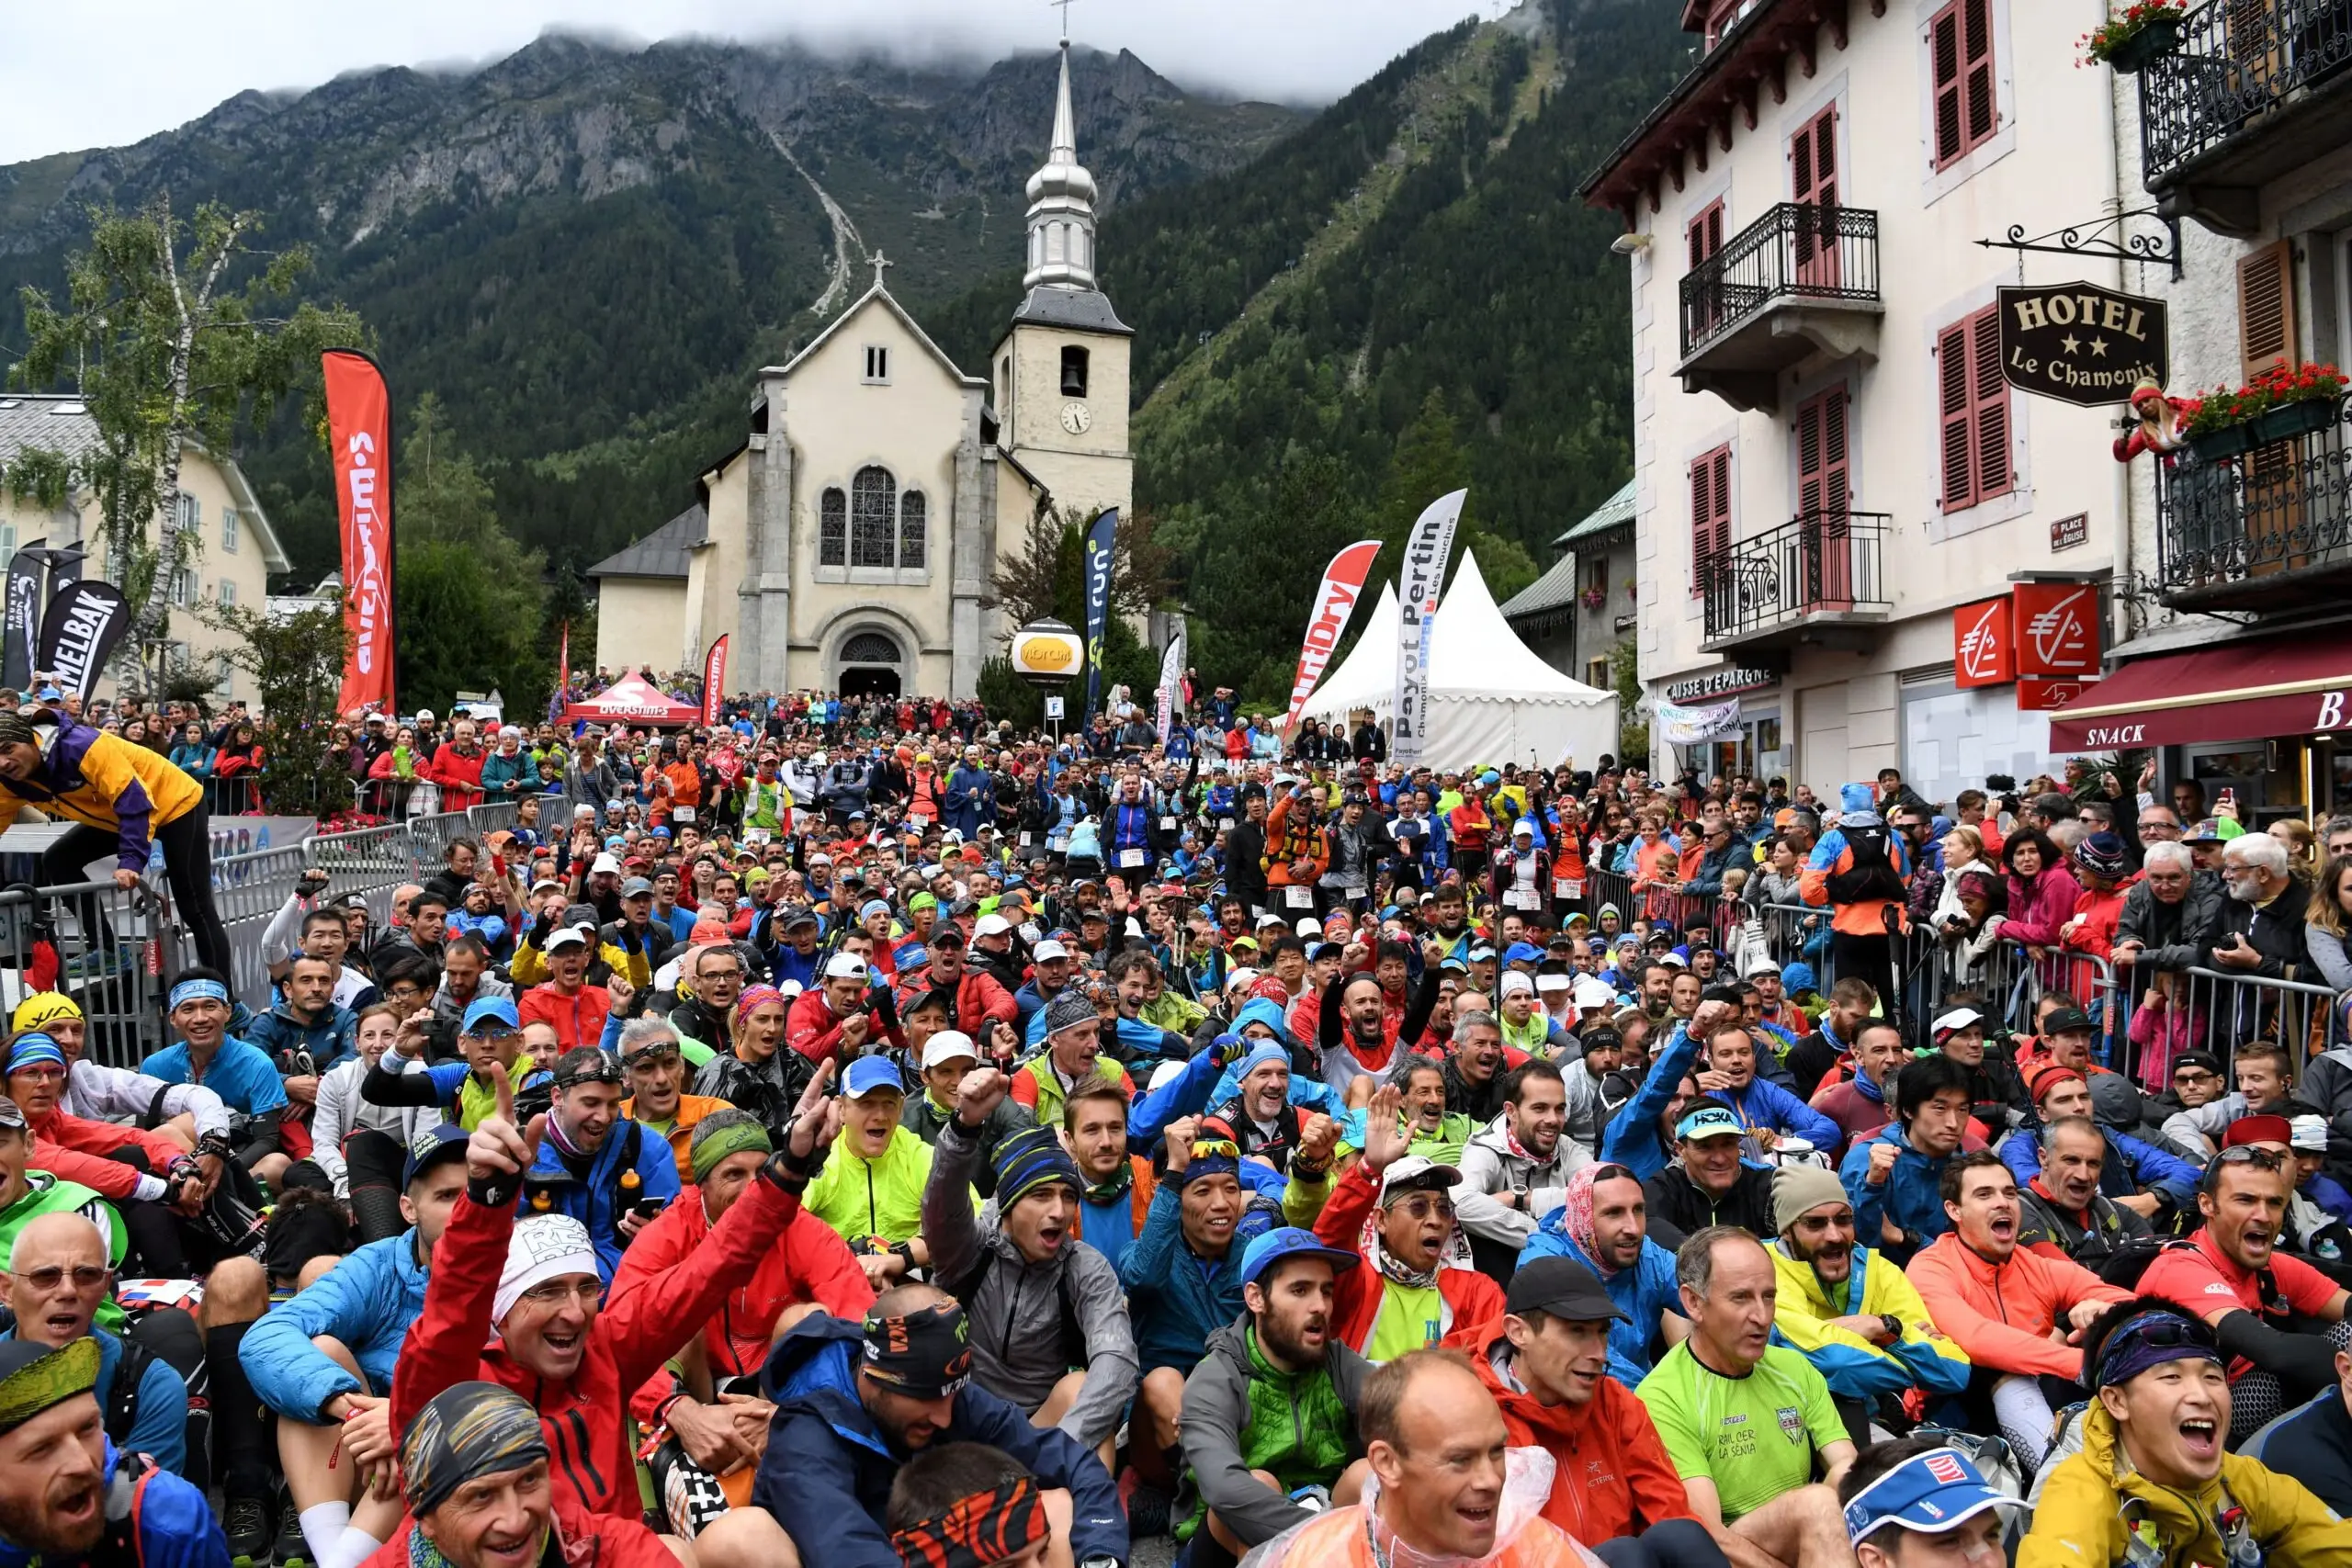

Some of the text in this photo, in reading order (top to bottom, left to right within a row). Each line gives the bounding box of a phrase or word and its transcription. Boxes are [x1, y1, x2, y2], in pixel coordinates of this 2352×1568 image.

[2014, 294, 2146, 342] HOTEL
[2010, 345, 2158, 390] Le Chamonix
[2061, 518, 2082, 533] PLACE
[1403, 522, 1440, 626] Pertin
[7, 572, 18, 630] MOUNTAIN
[1418, 674, 1427, 738] Chamonix
[1430, 573, 1441, 595] Les
[1436, 517, 1455, 571] houches
[1396, 641, 1419, 738] Payot
[2086, 692, 2352, 746] SNACK B
[1694, 1112, 1734, 1126] HOKA
[1719, 1448, 1728, 1459] LA
[1736, 1429, 1756, 1442] CER
